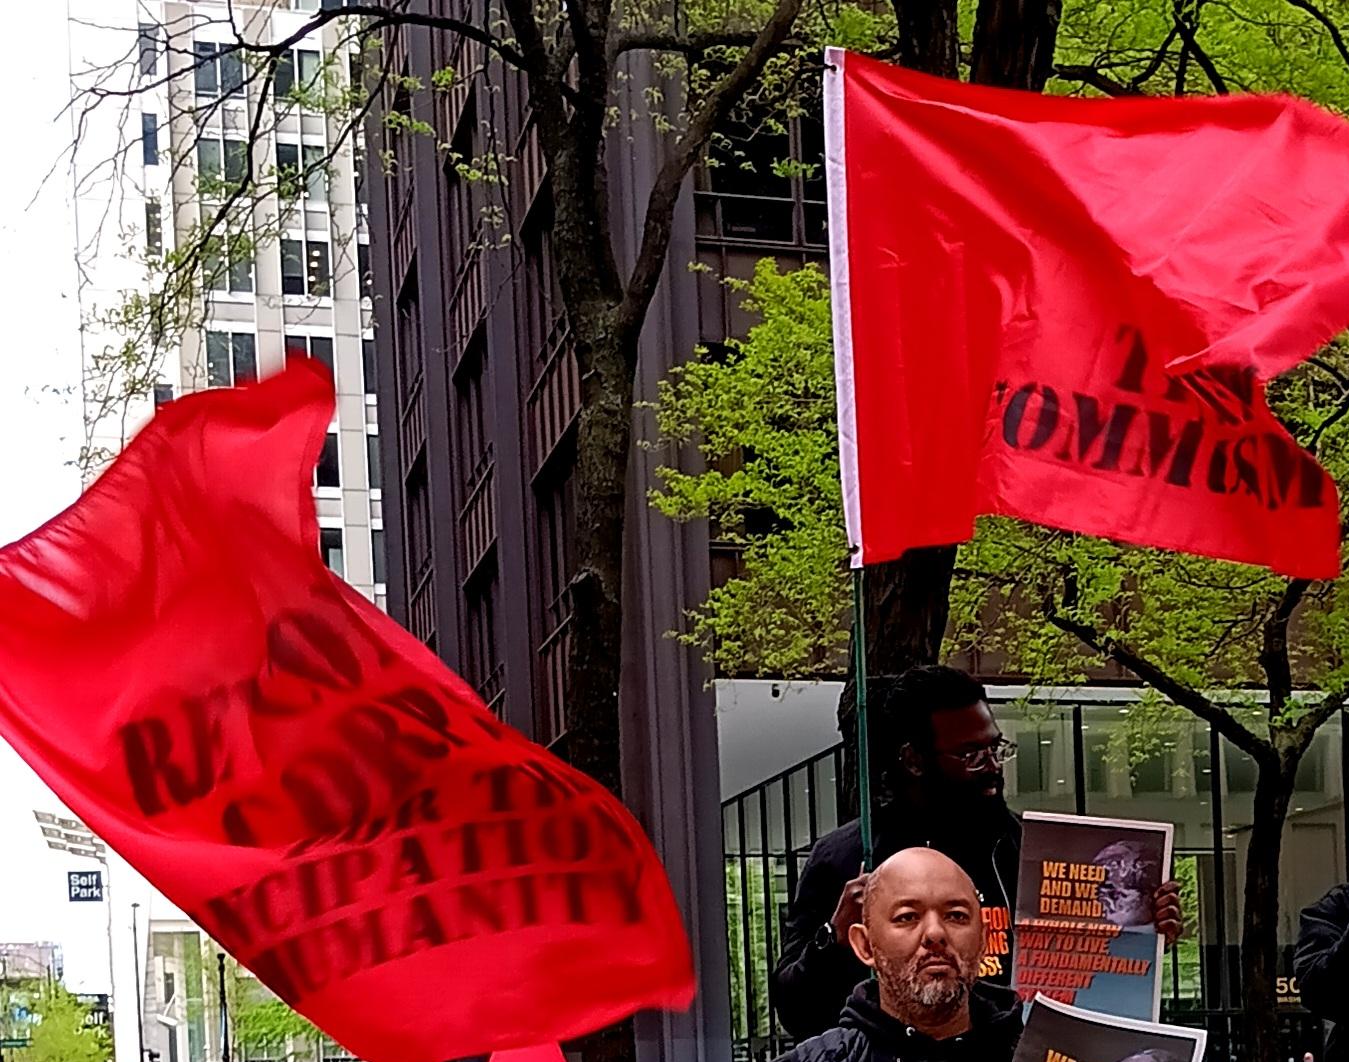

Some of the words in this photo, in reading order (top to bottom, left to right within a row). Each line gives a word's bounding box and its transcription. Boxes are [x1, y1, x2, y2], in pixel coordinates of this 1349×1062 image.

[1043, 861, 1065, 878] WE
[1069, 863, 1105, 882] NEED
[71, 886, 101, 898] Park
[1041, 880, 1071, 897] AND
[1075, 883, 1099, 899] WE
[1019, 931, 1053, 951] WAY
[1055, 934, 1075, 952] TO
[1018, 950, 1028, 967] A
[1031, 950, 1151, 976] FUNDAMENTALLY
[1018, 970, 1094, 989] DIFFERENT
